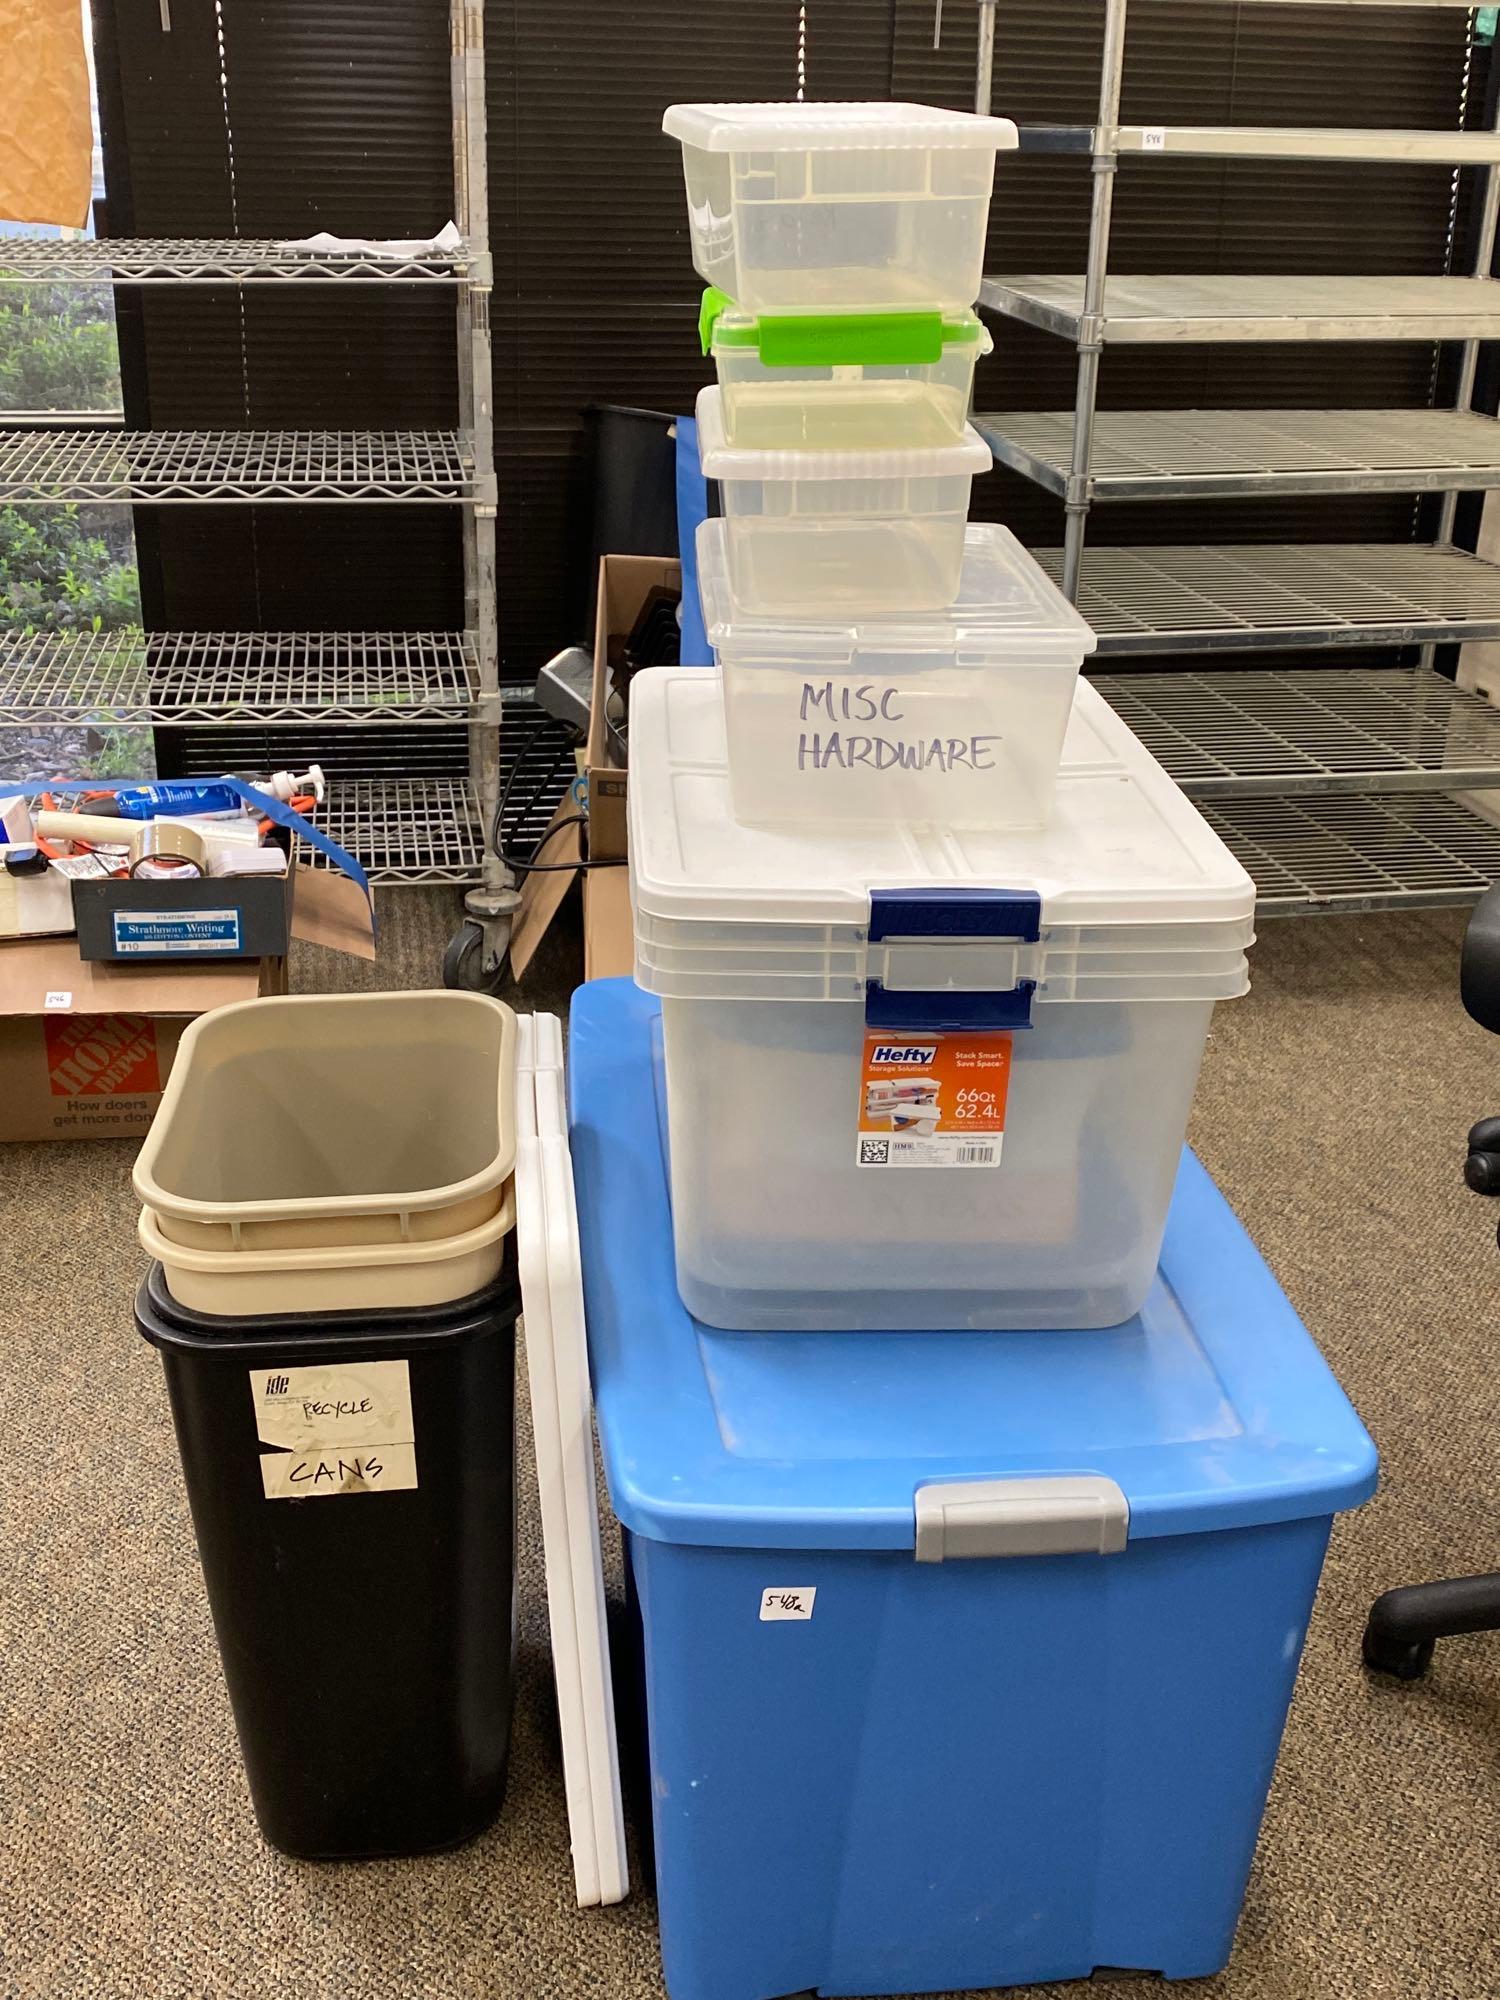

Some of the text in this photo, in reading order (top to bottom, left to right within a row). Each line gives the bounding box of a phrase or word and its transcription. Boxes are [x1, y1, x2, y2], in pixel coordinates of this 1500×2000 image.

[800, 682, 904, 722] MISC
[798, 732, 1003, 773] HARDWARE
[128, 923, 225, 934] Strathmore Writing
[121, 943, 139, 951] #10
[95, 1034, 156, 1093] DEPOT
[875, 1048, 932, 1064] Hefty
[869, 1065, 896, 1073] Storage
[67, 1100, 147, 1111] How doers
[54, 1111, 155, 1127] get more don
[266, 1375, 289, 1395] ide
[303, 1397, 373, 1421] RECYCLE
[289, 1457, 384, 1484] CANS
